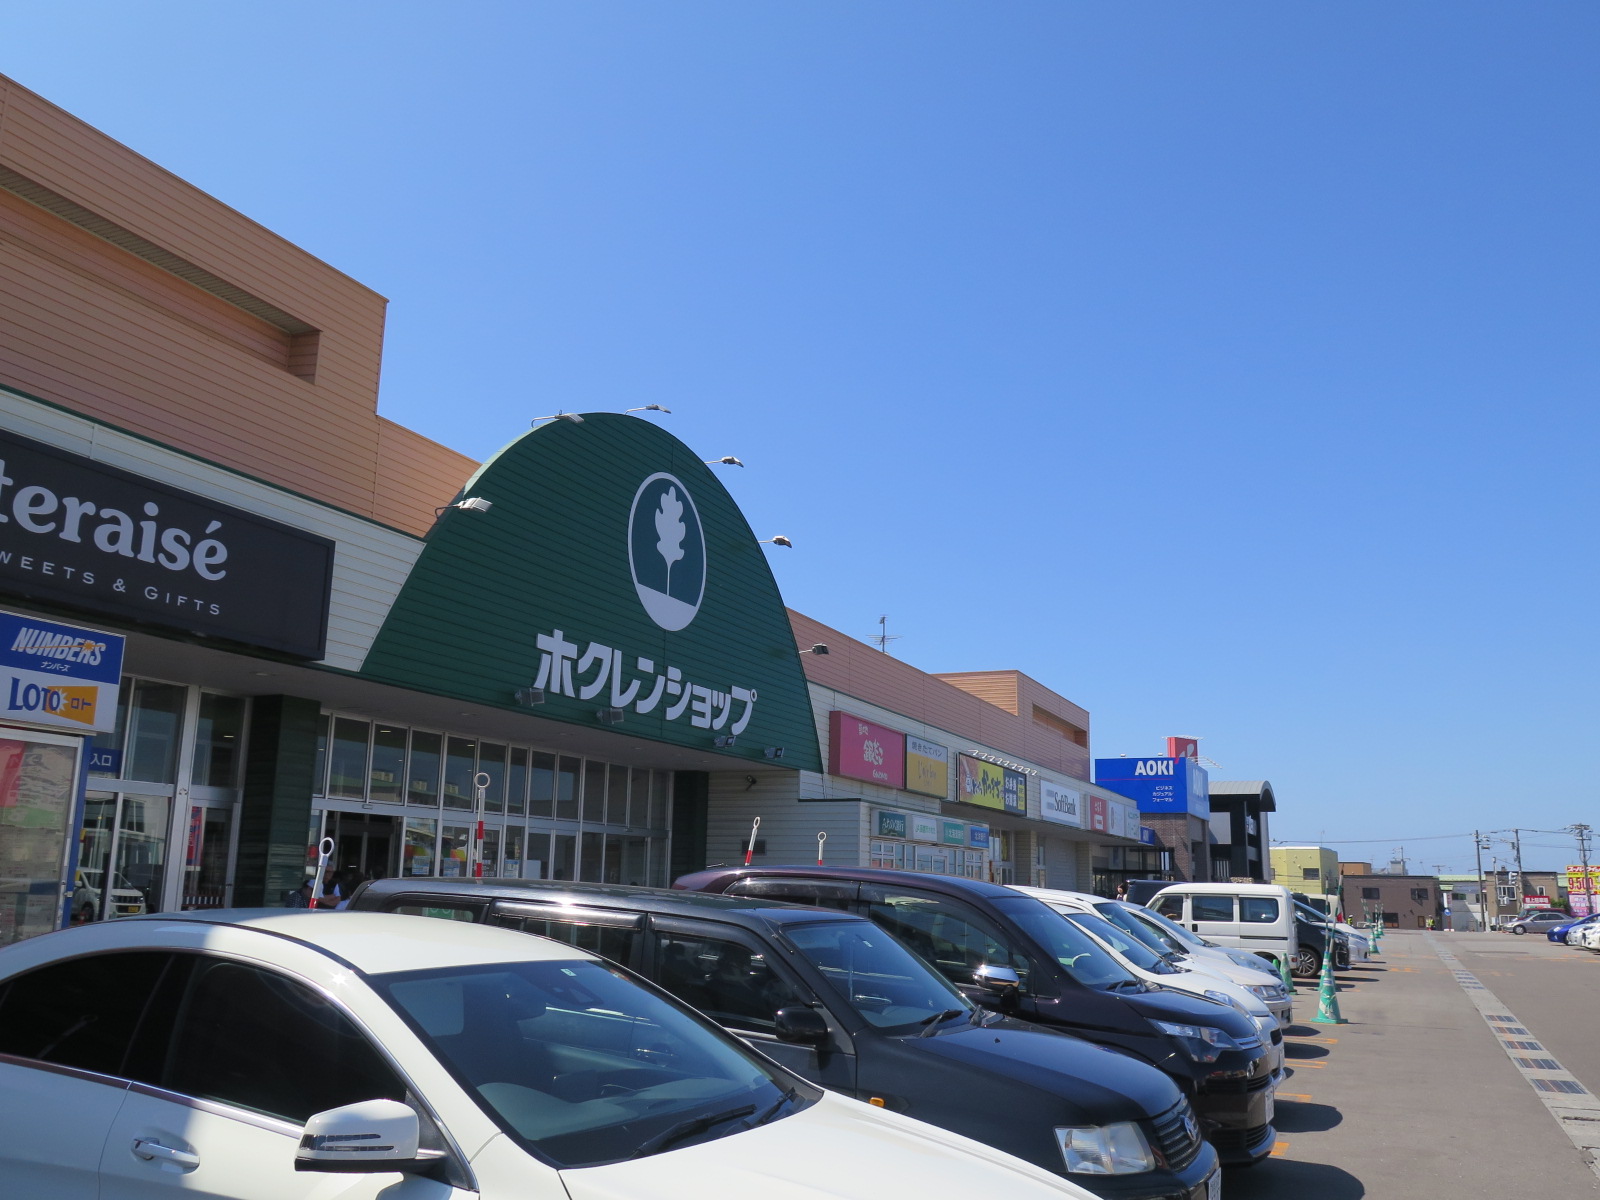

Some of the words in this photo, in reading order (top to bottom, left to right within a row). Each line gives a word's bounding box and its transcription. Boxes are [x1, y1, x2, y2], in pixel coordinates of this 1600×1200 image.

[112, 579, 126, 593] &
[144, 586, 220, 615] GIFTS
[11, 627, 106, 666] NUMBERS
[41, 661, 71, 672] ナンバーズ
[8, 677, 61, 711] LOTO
[533, 629, 758, 736] ホクレンショップ
[90, 753, 112, 766] 入口
[1134, 760, 1174, 776] AOKI
[1054, 792, 1076, 816] SoftBank
